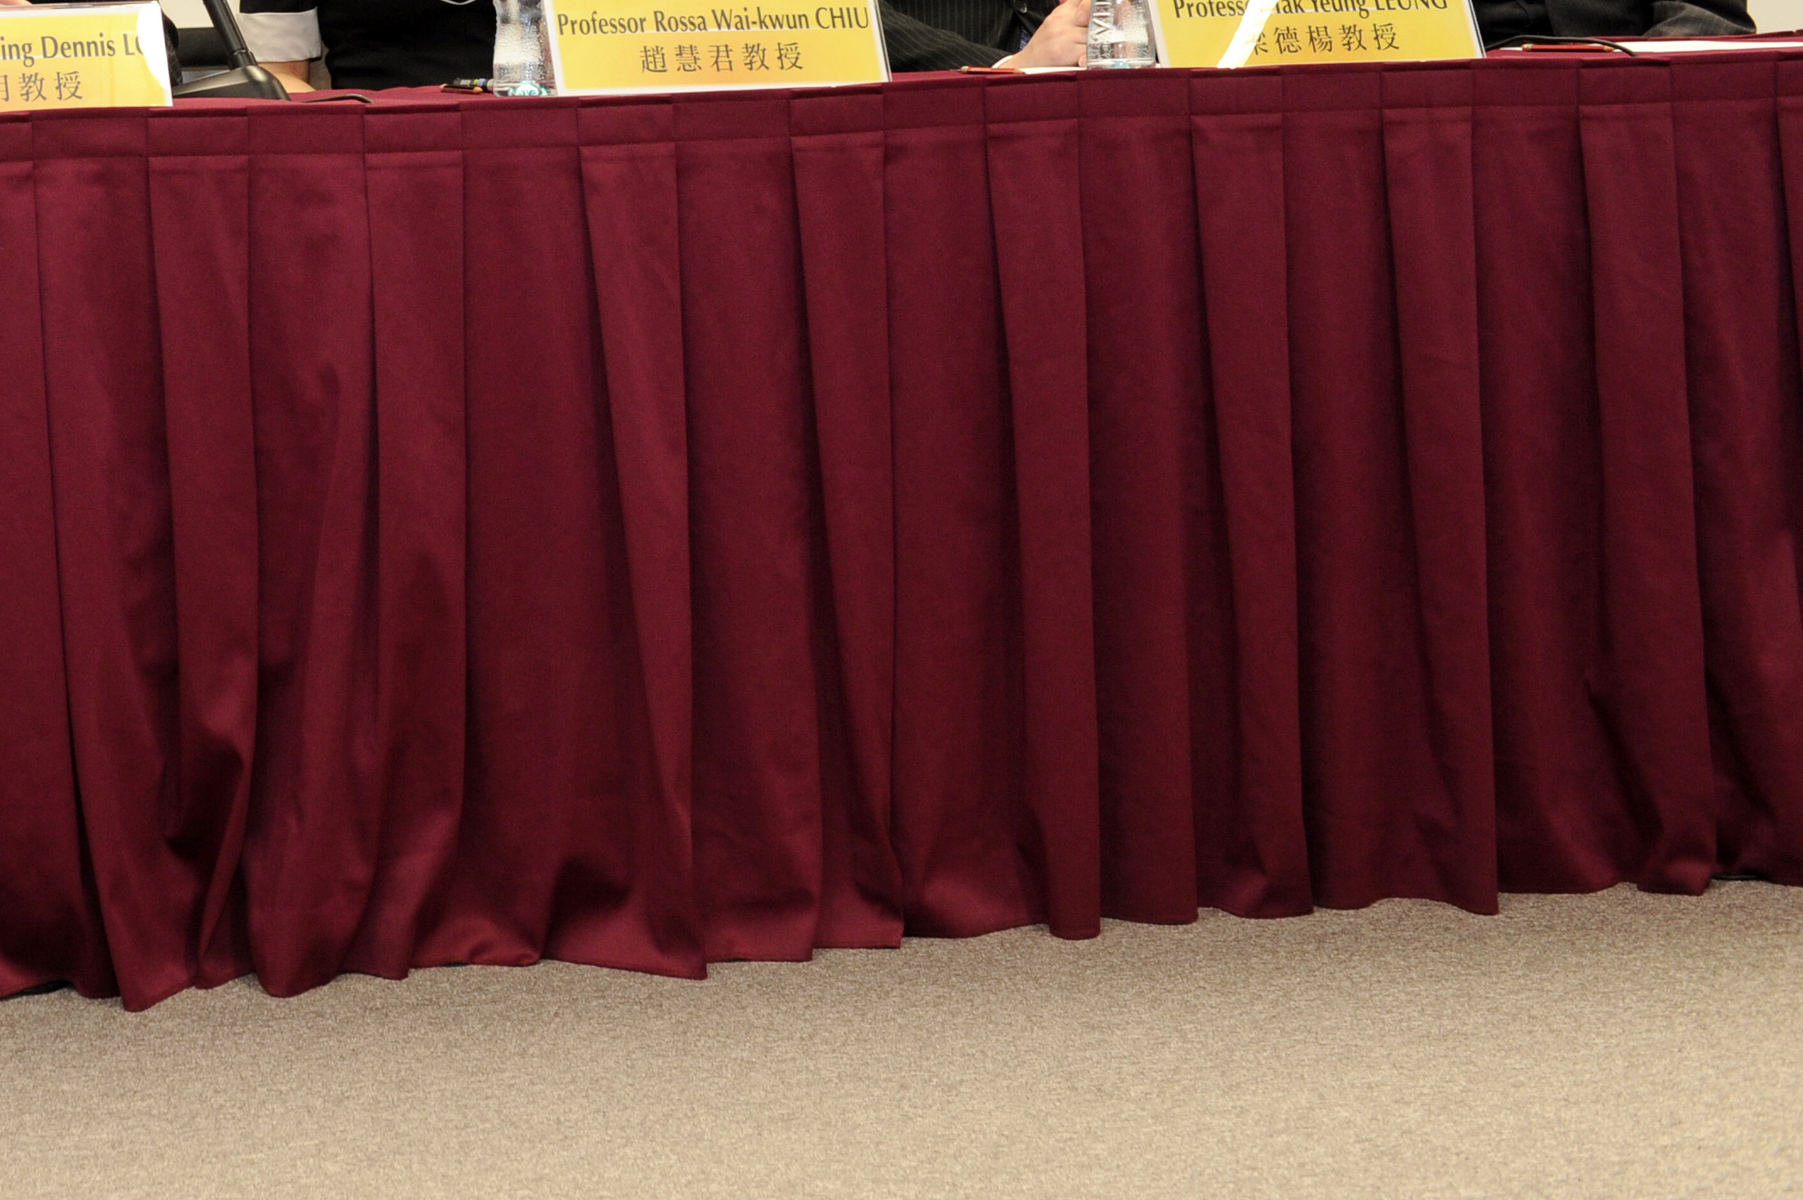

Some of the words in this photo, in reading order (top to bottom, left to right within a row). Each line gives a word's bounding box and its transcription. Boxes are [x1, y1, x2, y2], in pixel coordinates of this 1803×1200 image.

[557, 8, 647, 36] Professor
[653, 9, 707, 33] Rossa
[712, 6, 809, 32] Wai-kwun
[815, 5, 870, 30] CHIU
[41, 32, 116, 59] Dennis
[640, 40, 805, 75] 趙慧君教授
